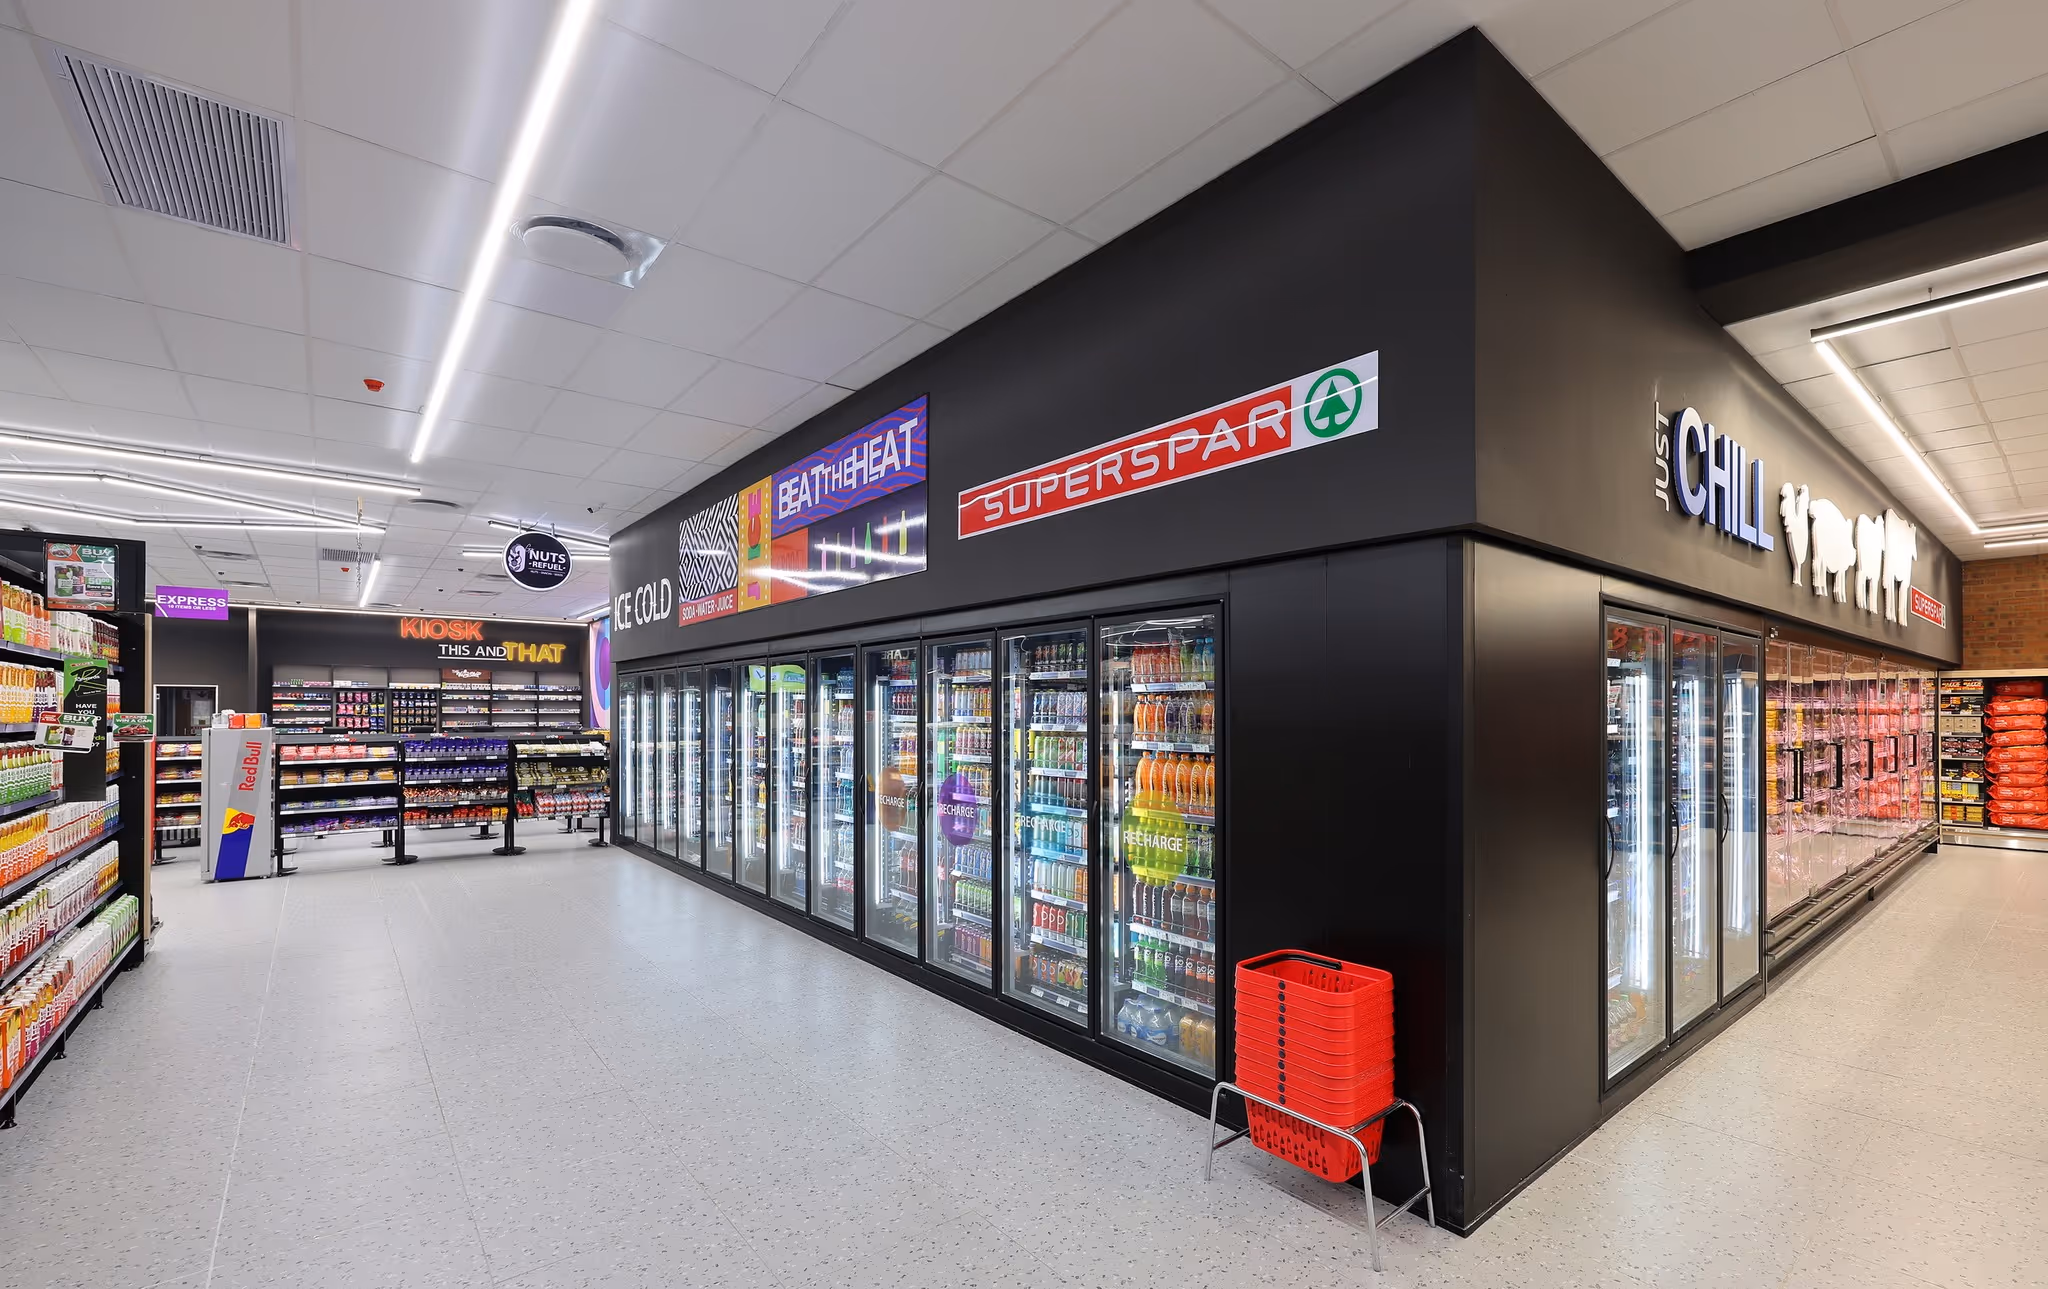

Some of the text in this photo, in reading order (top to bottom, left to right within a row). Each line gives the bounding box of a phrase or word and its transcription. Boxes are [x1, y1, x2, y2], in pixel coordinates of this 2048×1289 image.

[983, 399, 1287, 522] SUPERSPAR
[1655, 401, 1670, 511] JUST
[778, 417, 918, 520] BEAT THE HEAT
[1673, 406, 1774, 551] CHILL
[529, 550, 566, 564] NUTS
[532, 561, 563, 571] REFUEL
[157, 595, 227, 607] EXPRESS
[614, 578, 672, 632] ICE COLD
[1914, 593, 1942, 620] SUPERSPAR
[400, 617, 484, 641] KIOSK
[438, 644, 507, 657] THIS AND
[502, 641, 567, 664] THAT
[63, 714, 91, 722] BUY
[238, 741, 263, 792] Red Bull
[938, 803, 975, 818] RECHARGE
[1123, 830, 1184, 853] RECHARGE
